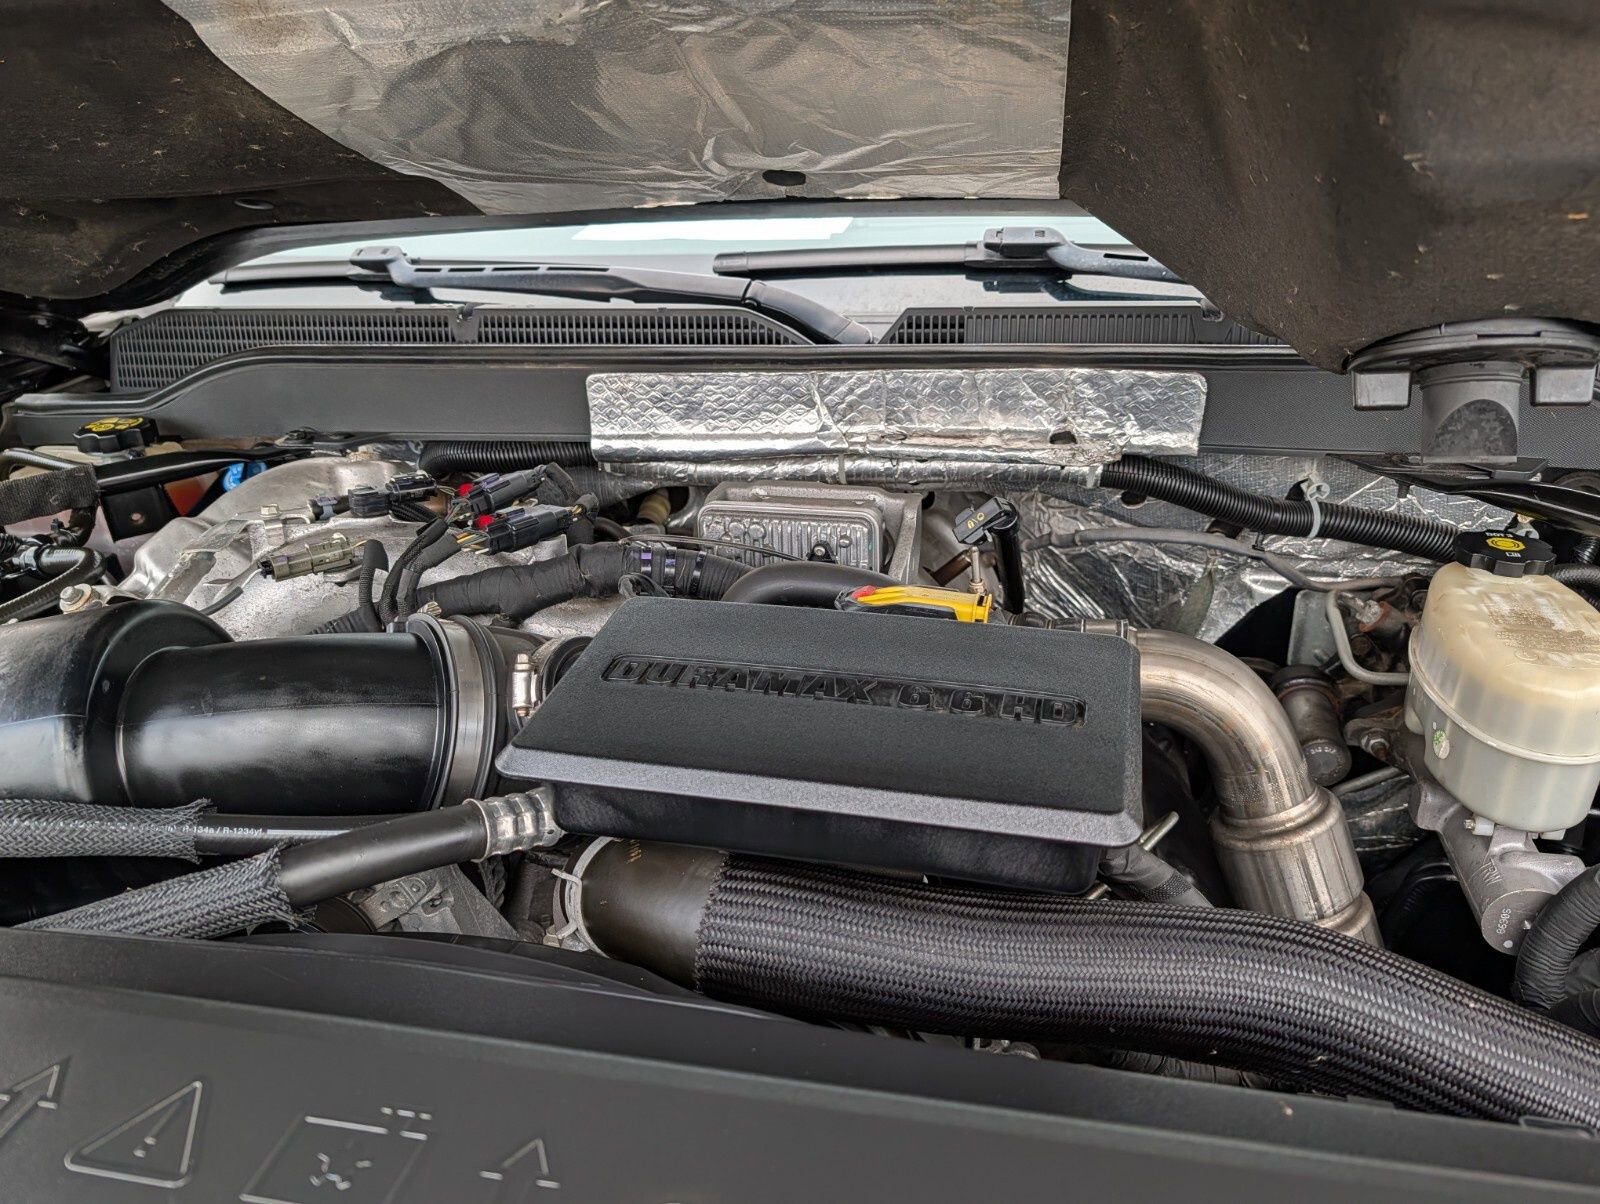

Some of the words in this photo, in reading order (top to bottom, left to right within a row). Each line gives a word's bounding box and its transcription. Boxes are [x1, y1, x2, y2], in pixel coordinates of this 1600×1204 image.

[605, 660, 878, 704] DURAMAX
[1000, 692, 1077, 726] HD
[222, 826, 263, 837] R-1234yf
[1479, 857, 1503, 887] TRW
